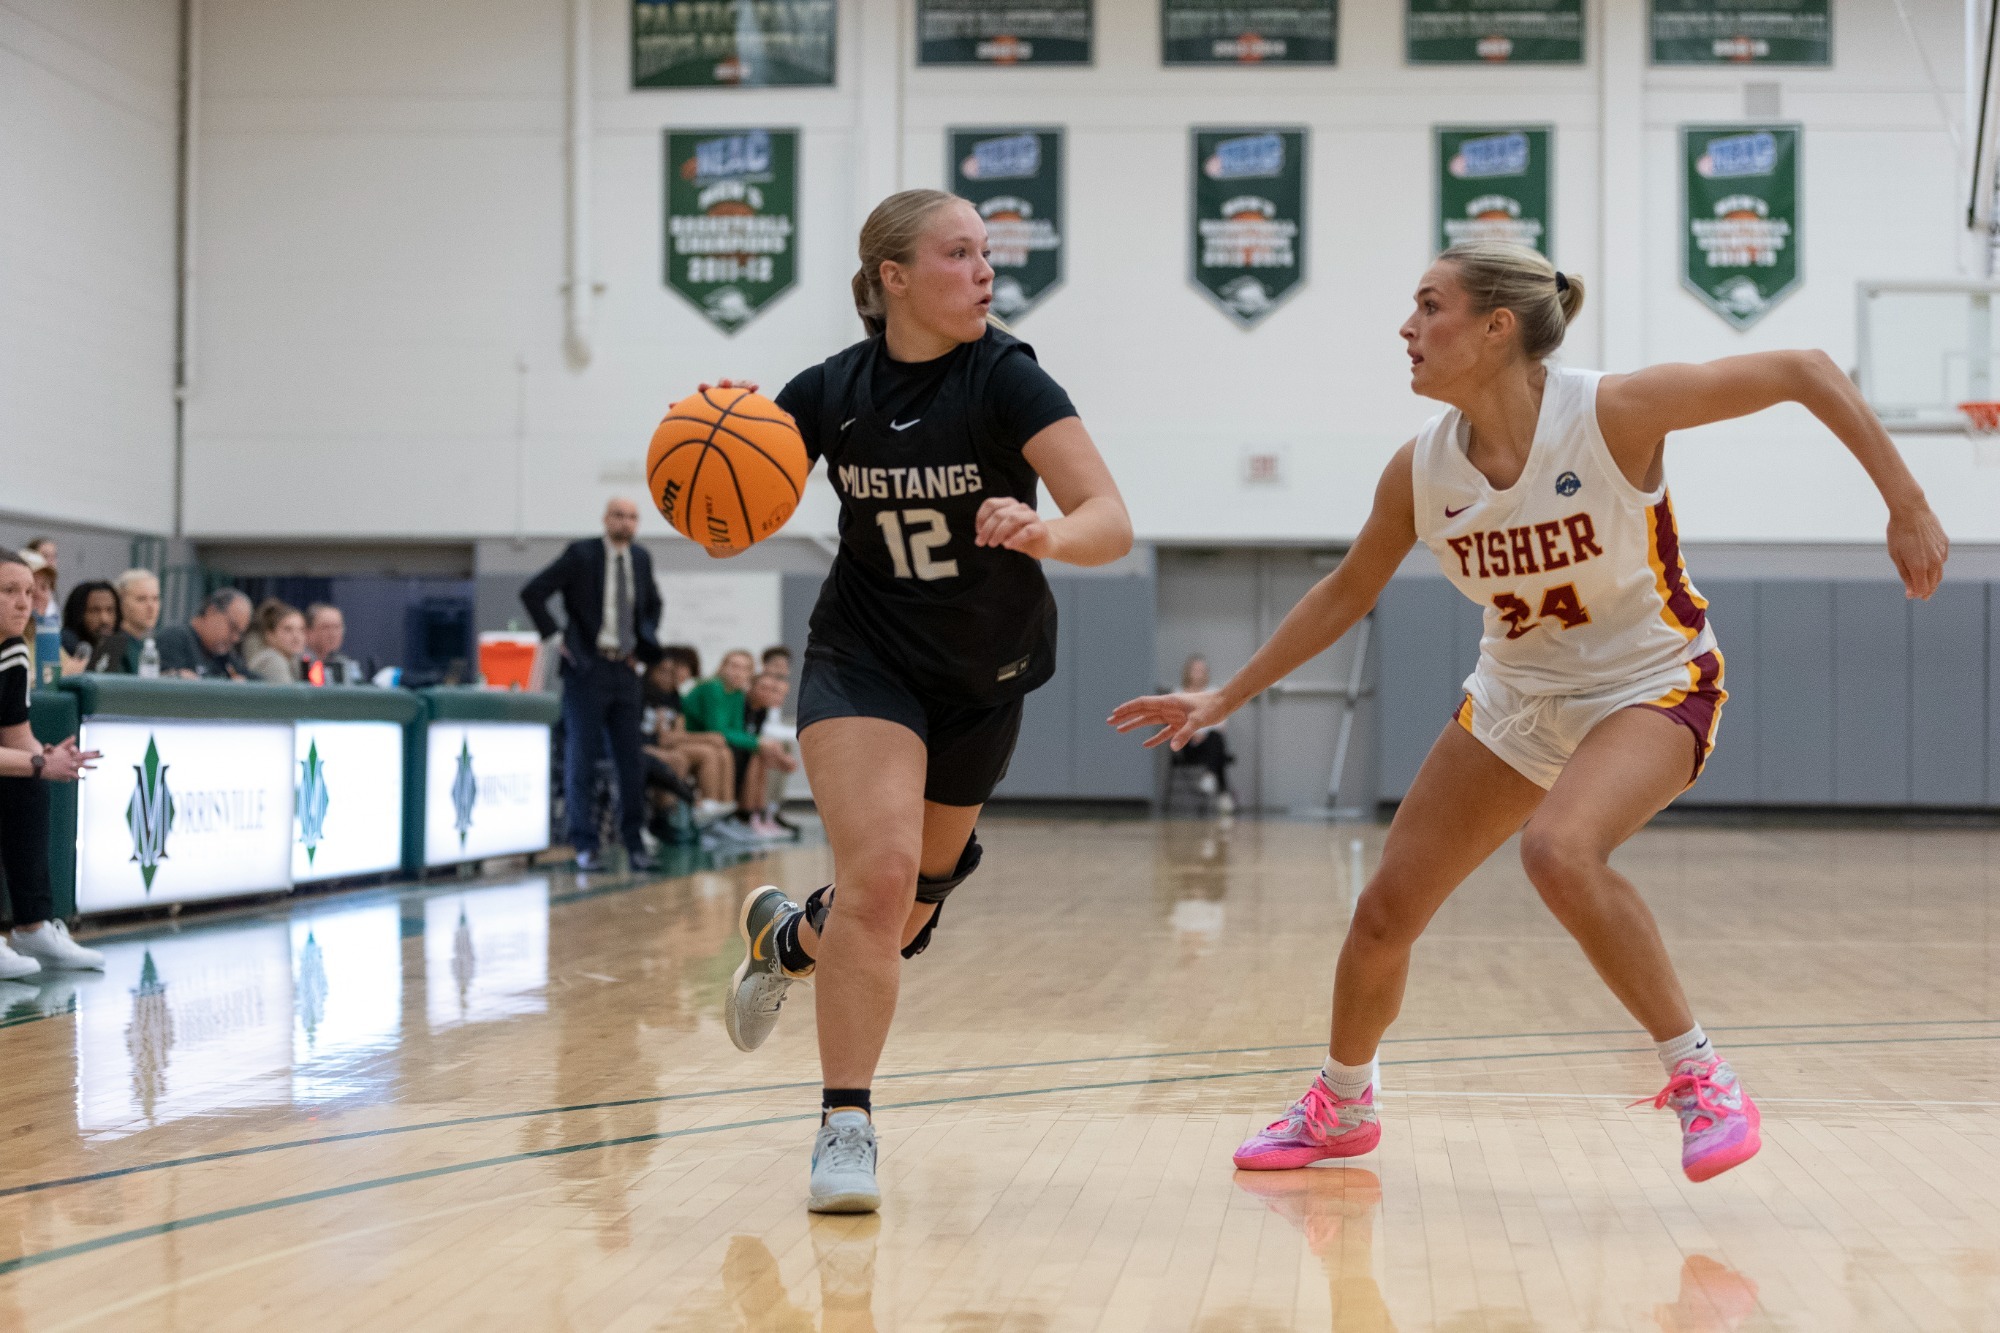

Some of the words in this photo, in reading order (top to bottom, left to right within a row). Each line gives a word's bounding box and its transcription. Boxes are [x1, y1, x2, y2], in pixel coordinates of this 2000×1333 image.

[838, 463, 982, 499] MUSTANGS
[875, 508, 959, 581] 12
[1447, 512, 1603, 578] FISHER
[1491, 581, 1592, 640] 24
